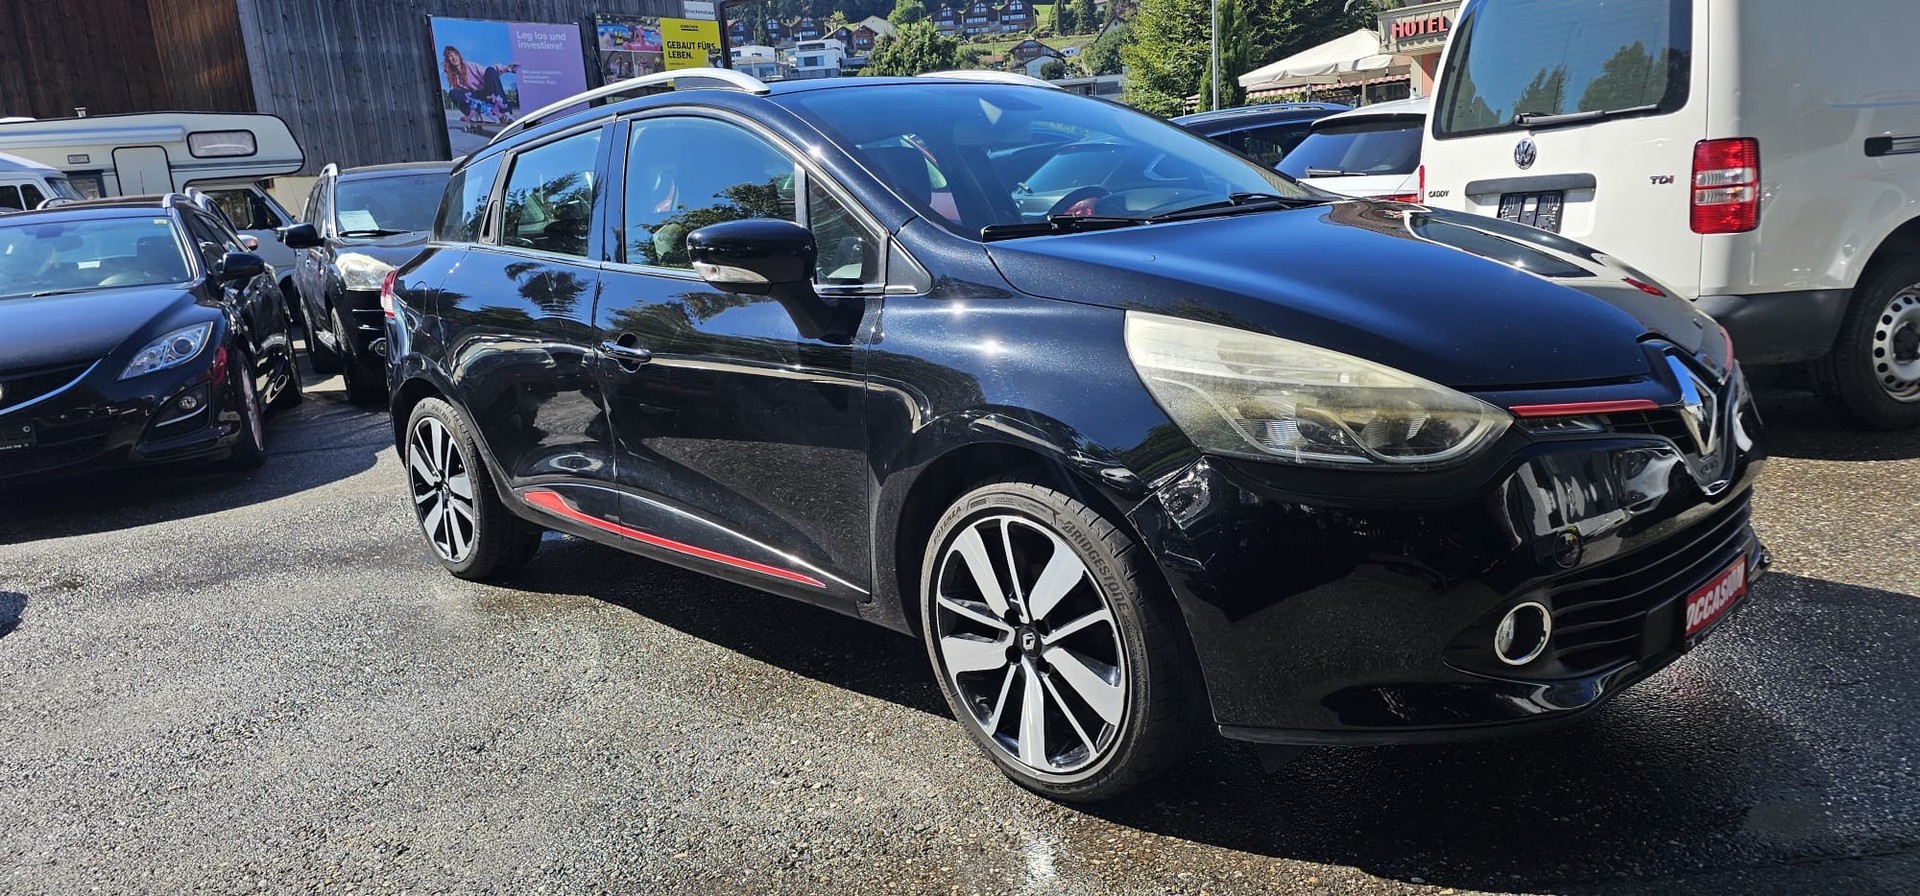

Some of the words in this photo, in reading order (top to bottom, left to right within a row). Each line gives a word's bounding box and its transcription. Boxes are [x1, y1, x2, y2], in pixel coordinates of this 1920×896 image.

[1391, 16, 1449, 39] HOTEL
[516, 30, 532, 41] Leg
[534, 31, 547, 40] los
[549, 33, 566, 41] und
[517, 39, 563, 50] investiere!
[667, 41, 695, 50] GEBAUT
[697, 41, 716, 51] FÜRS
[668, 50, 693, 59] LEBEN.
[1428, 190, 1450, 198] CADDY
[933, 505, 962, 544] POTENZA
[1061, 520, 1130, 612] BRIDGESTONE
